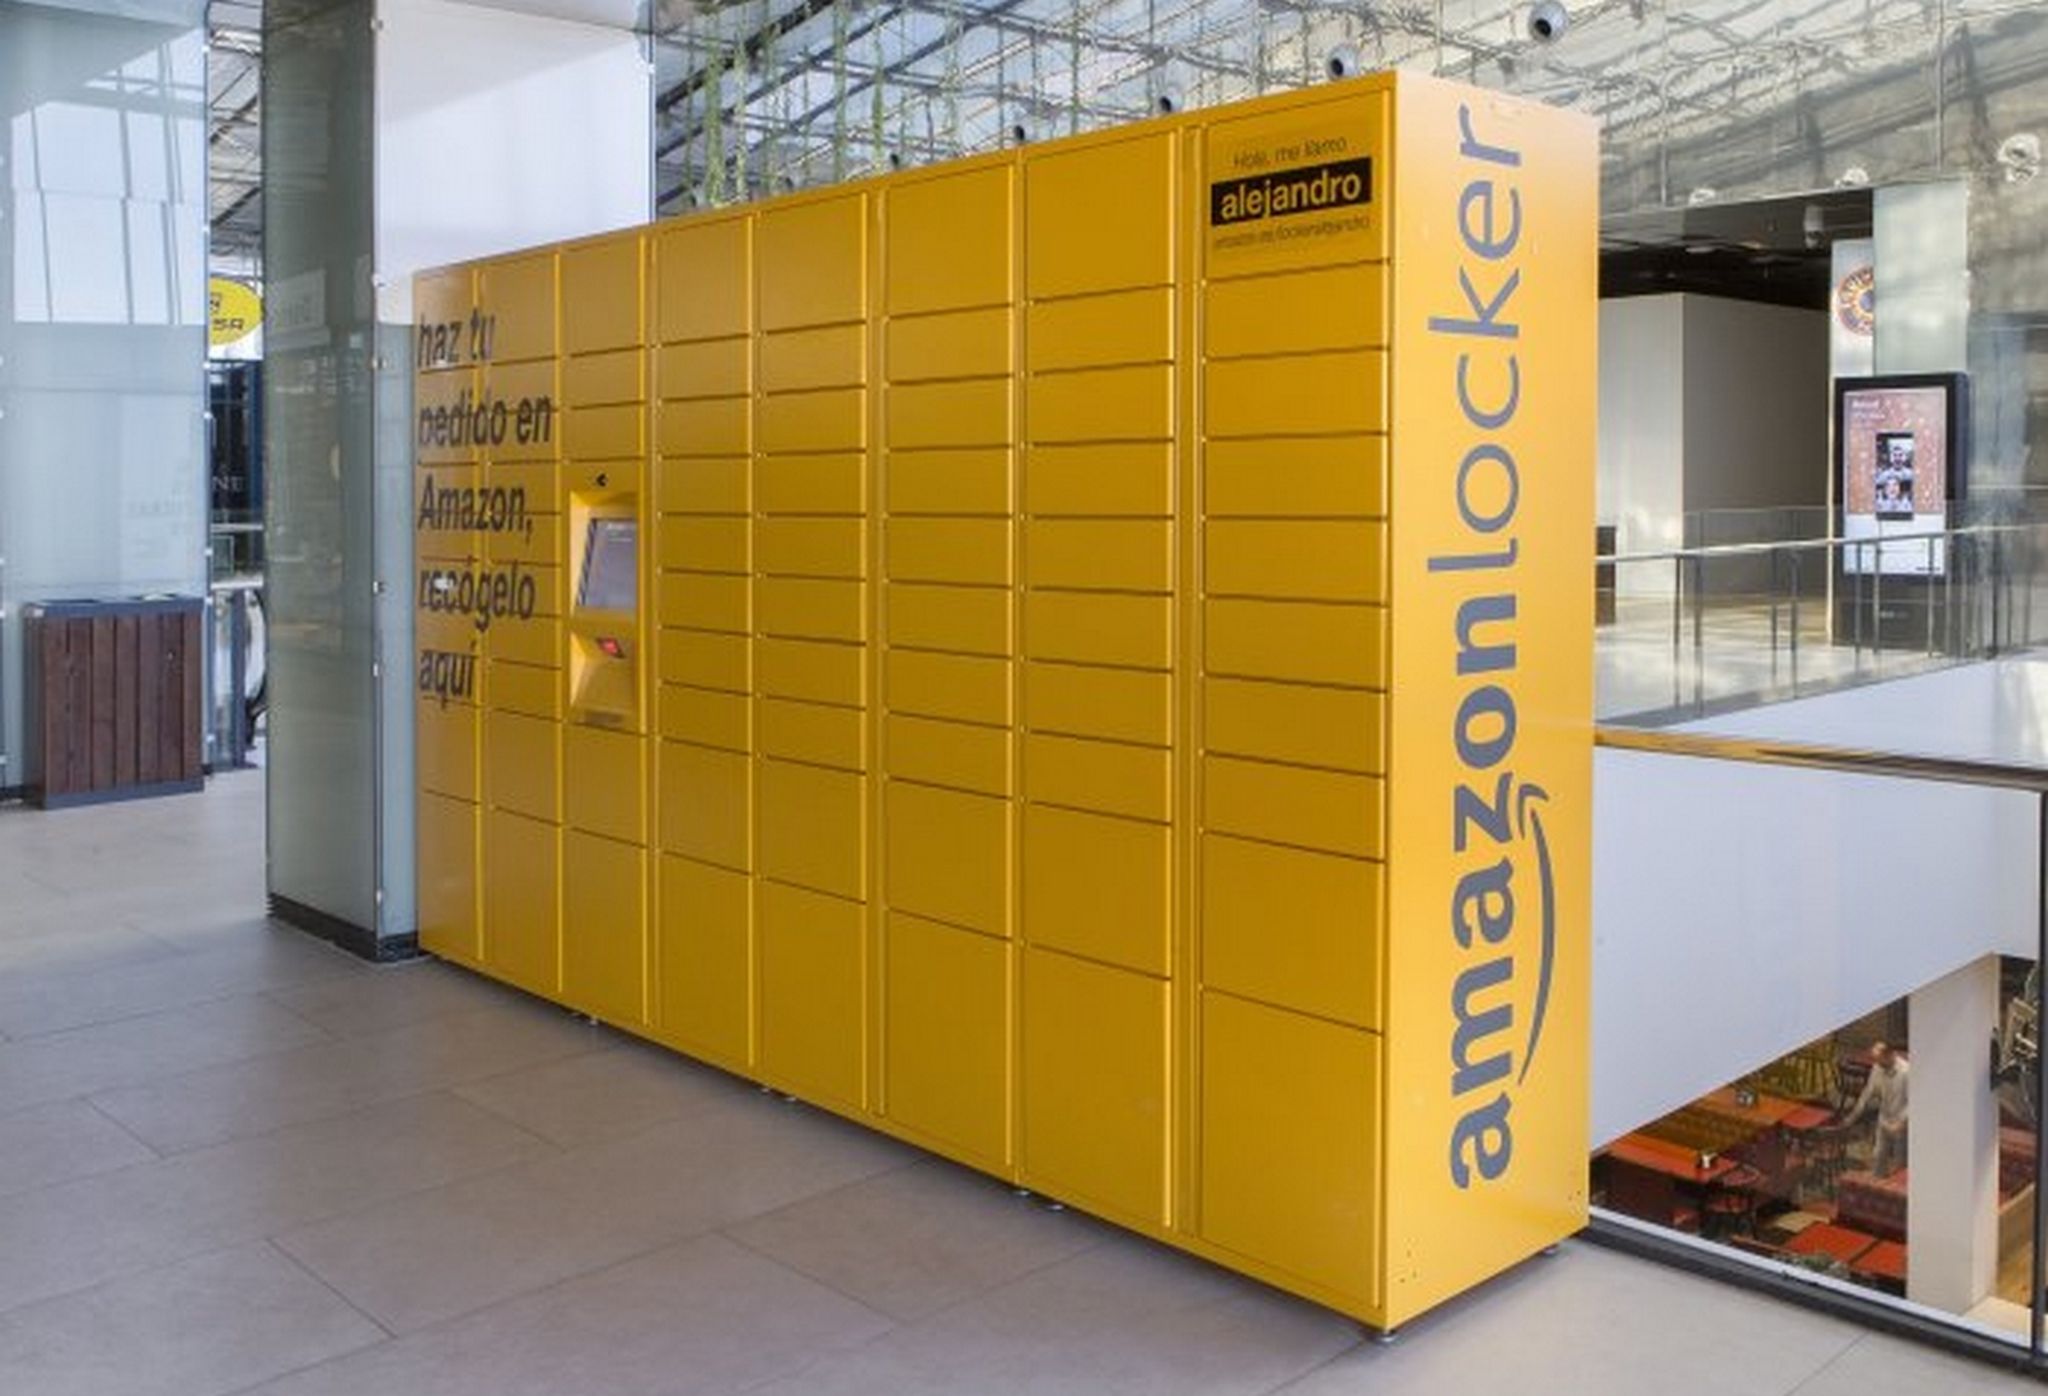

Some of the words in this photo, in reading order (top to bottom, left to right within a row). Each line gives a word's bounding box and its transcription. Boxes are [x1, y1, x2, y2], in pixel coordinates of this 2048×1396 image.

[1220, 168, 1361, 219] alejandro
[417, 314, 462, 368] haz
[470, 308, 495, 361] tu
[419, 387, 507, 446] pedido
[517, 395, 550, 445] en
[417, 474, 533, 544] Amazon,
[419, 555, 535, 633] recógelo
[419, 640, 477, 709] aquí
